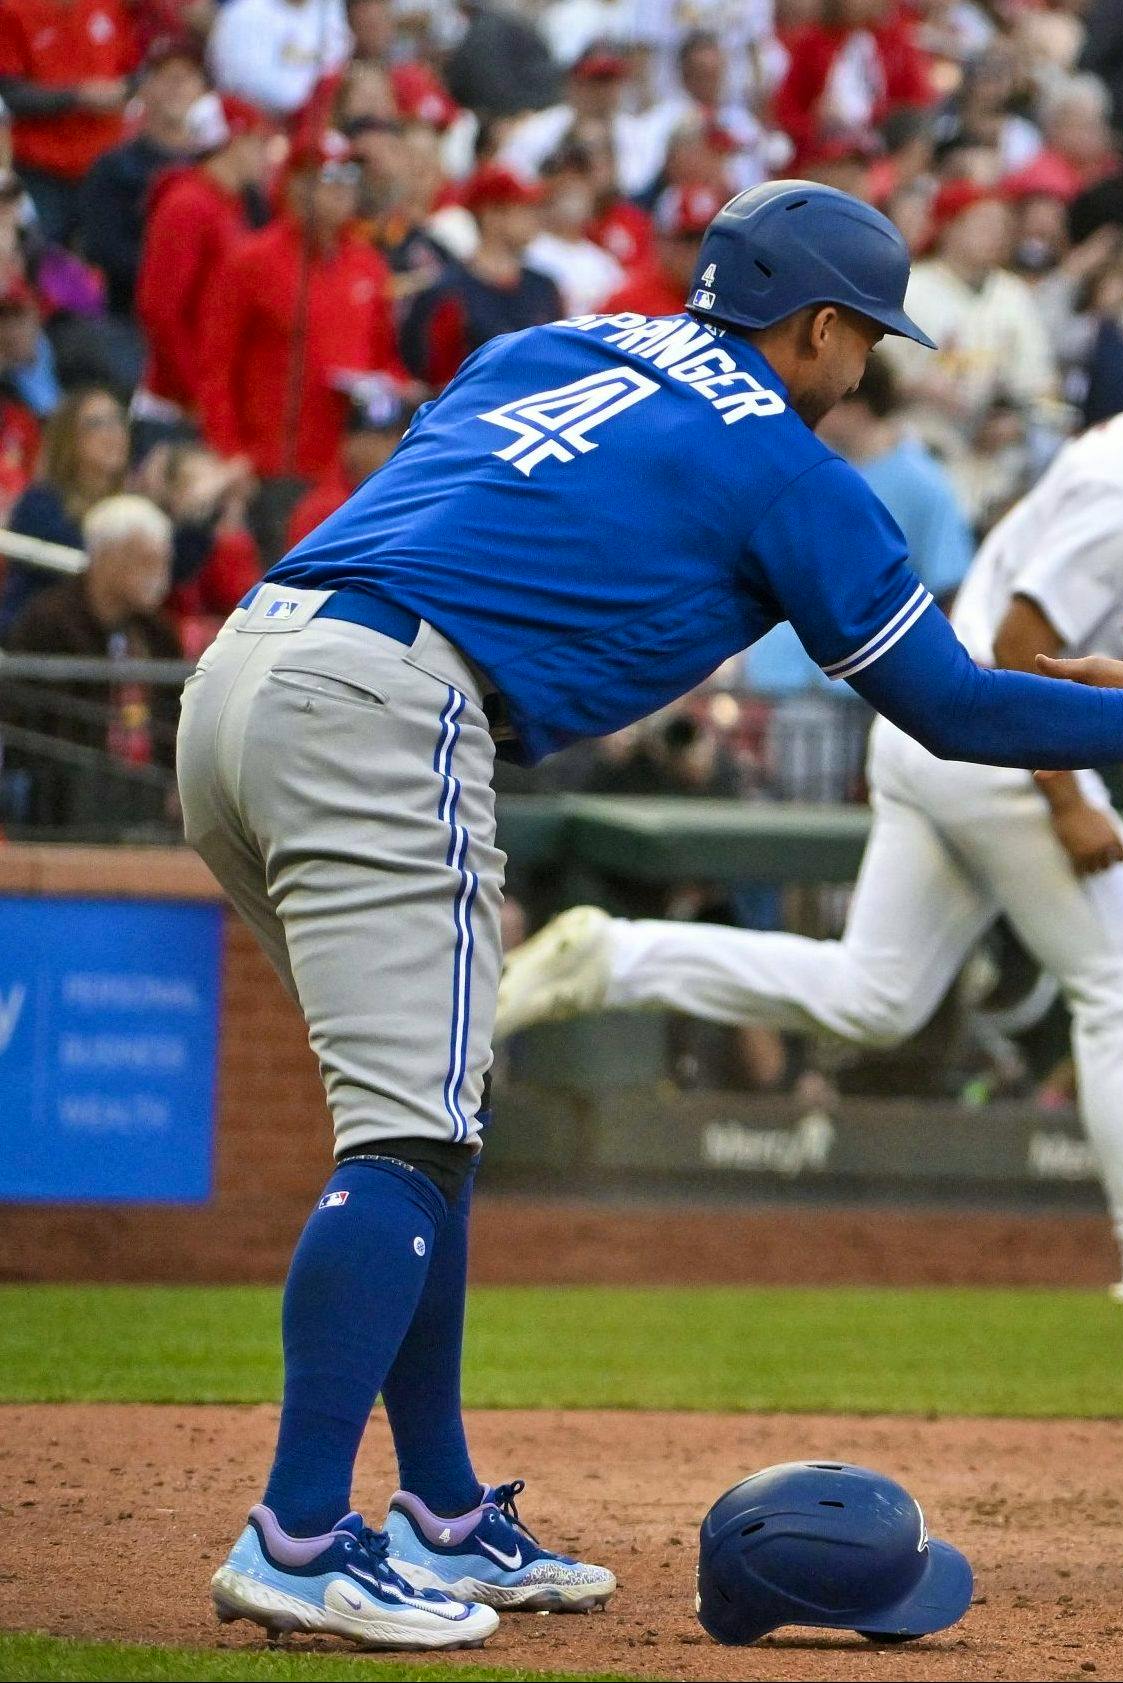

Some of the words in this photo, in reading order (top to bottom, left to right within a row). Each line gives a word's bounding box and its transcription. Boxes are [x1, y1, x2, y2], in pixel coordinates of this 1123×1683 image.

[701, 263, 717, 288] 4
[476, 366, 661, 477] 4
[439, 1528, 451, 1543] 4
